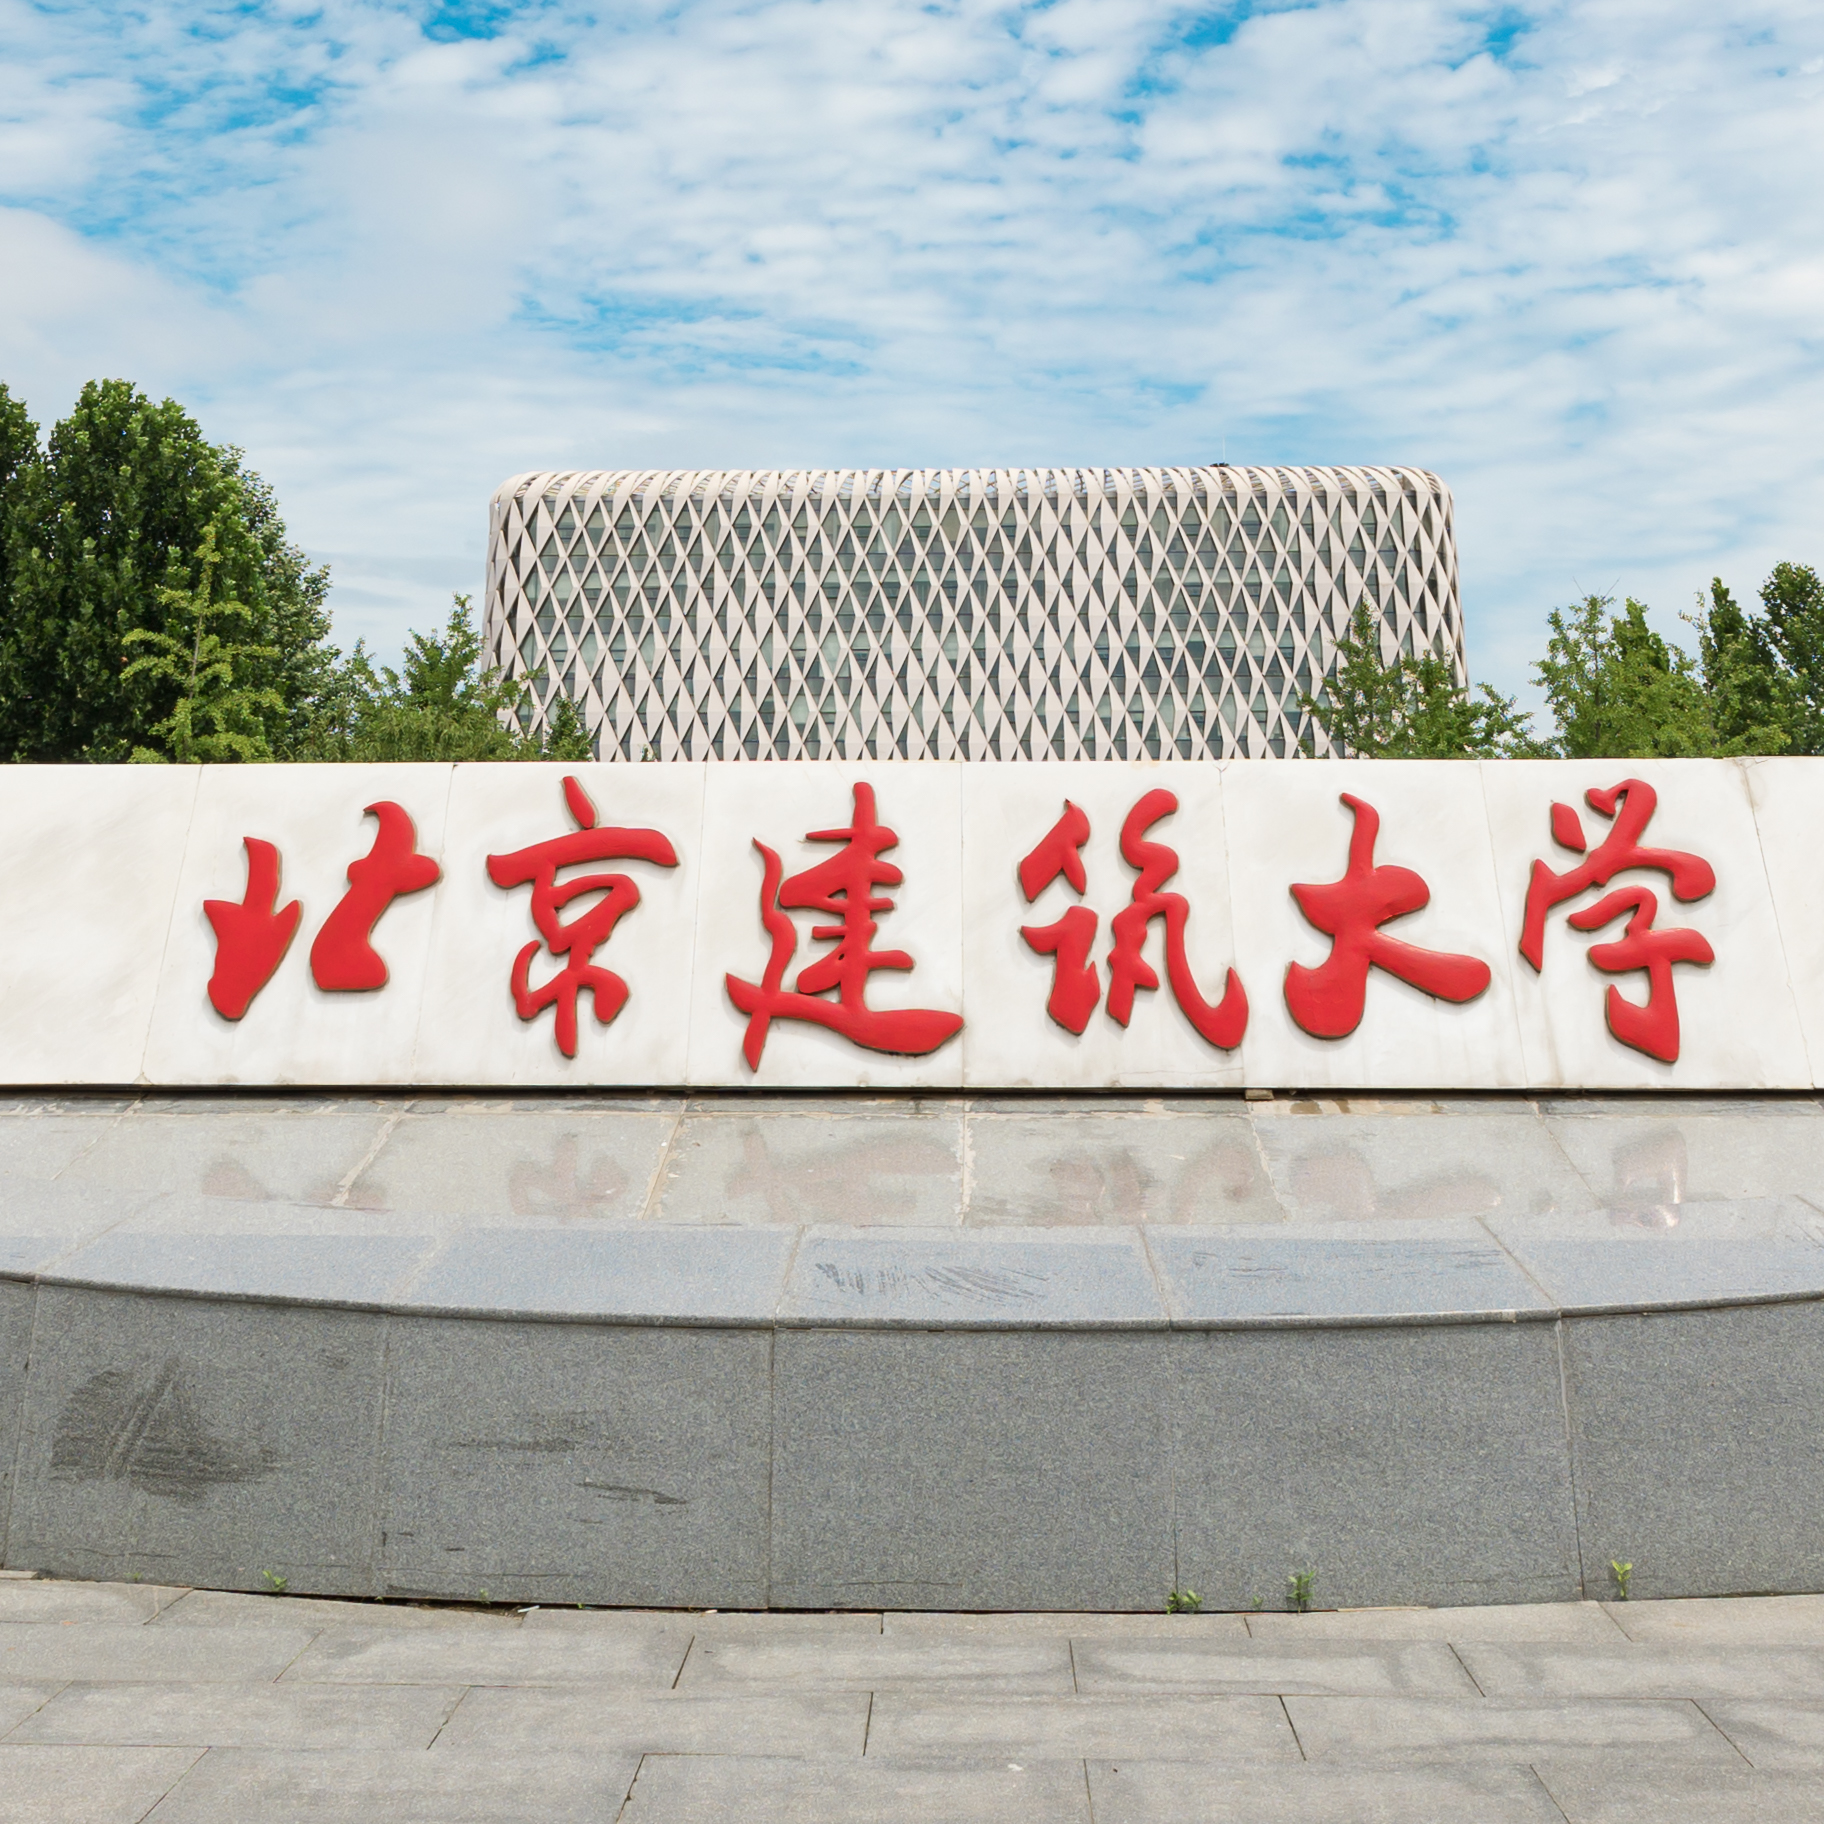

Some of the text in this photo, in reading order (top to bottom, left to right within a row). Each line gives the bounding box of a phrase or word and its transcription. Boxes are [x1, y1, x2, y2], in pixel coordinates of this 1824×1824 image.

[204, 777, 1719, 1070] 北京建筑大学
